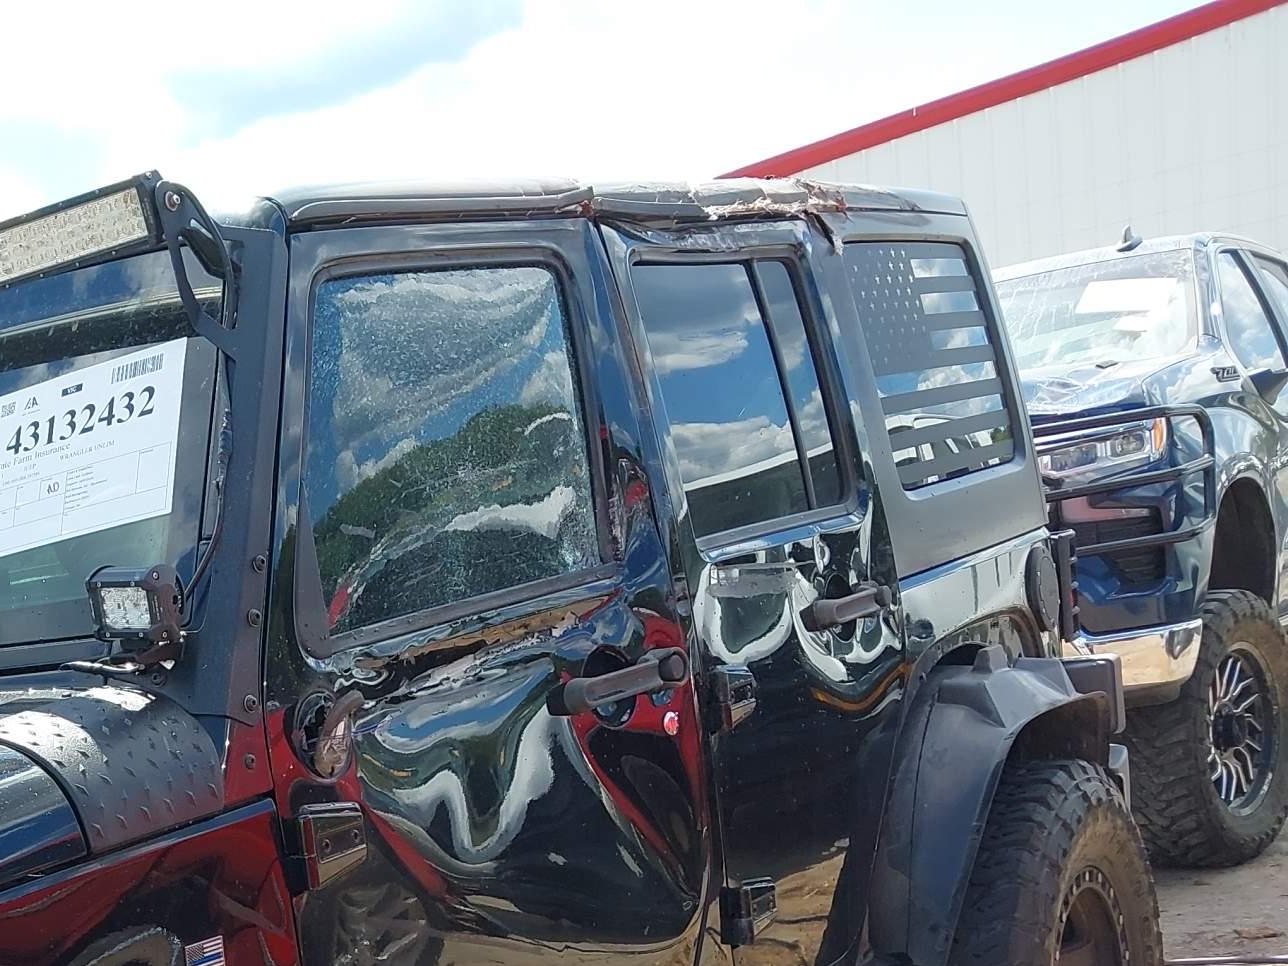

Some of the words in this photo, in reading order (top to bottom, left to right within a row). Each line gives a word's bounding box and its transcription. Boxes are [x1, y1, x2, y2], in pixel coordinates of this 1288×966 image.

[6, 386, 156, 455] 43132432
[13, 454, 33, 467] Farm
[34, 443, 72, 459] Insurance
